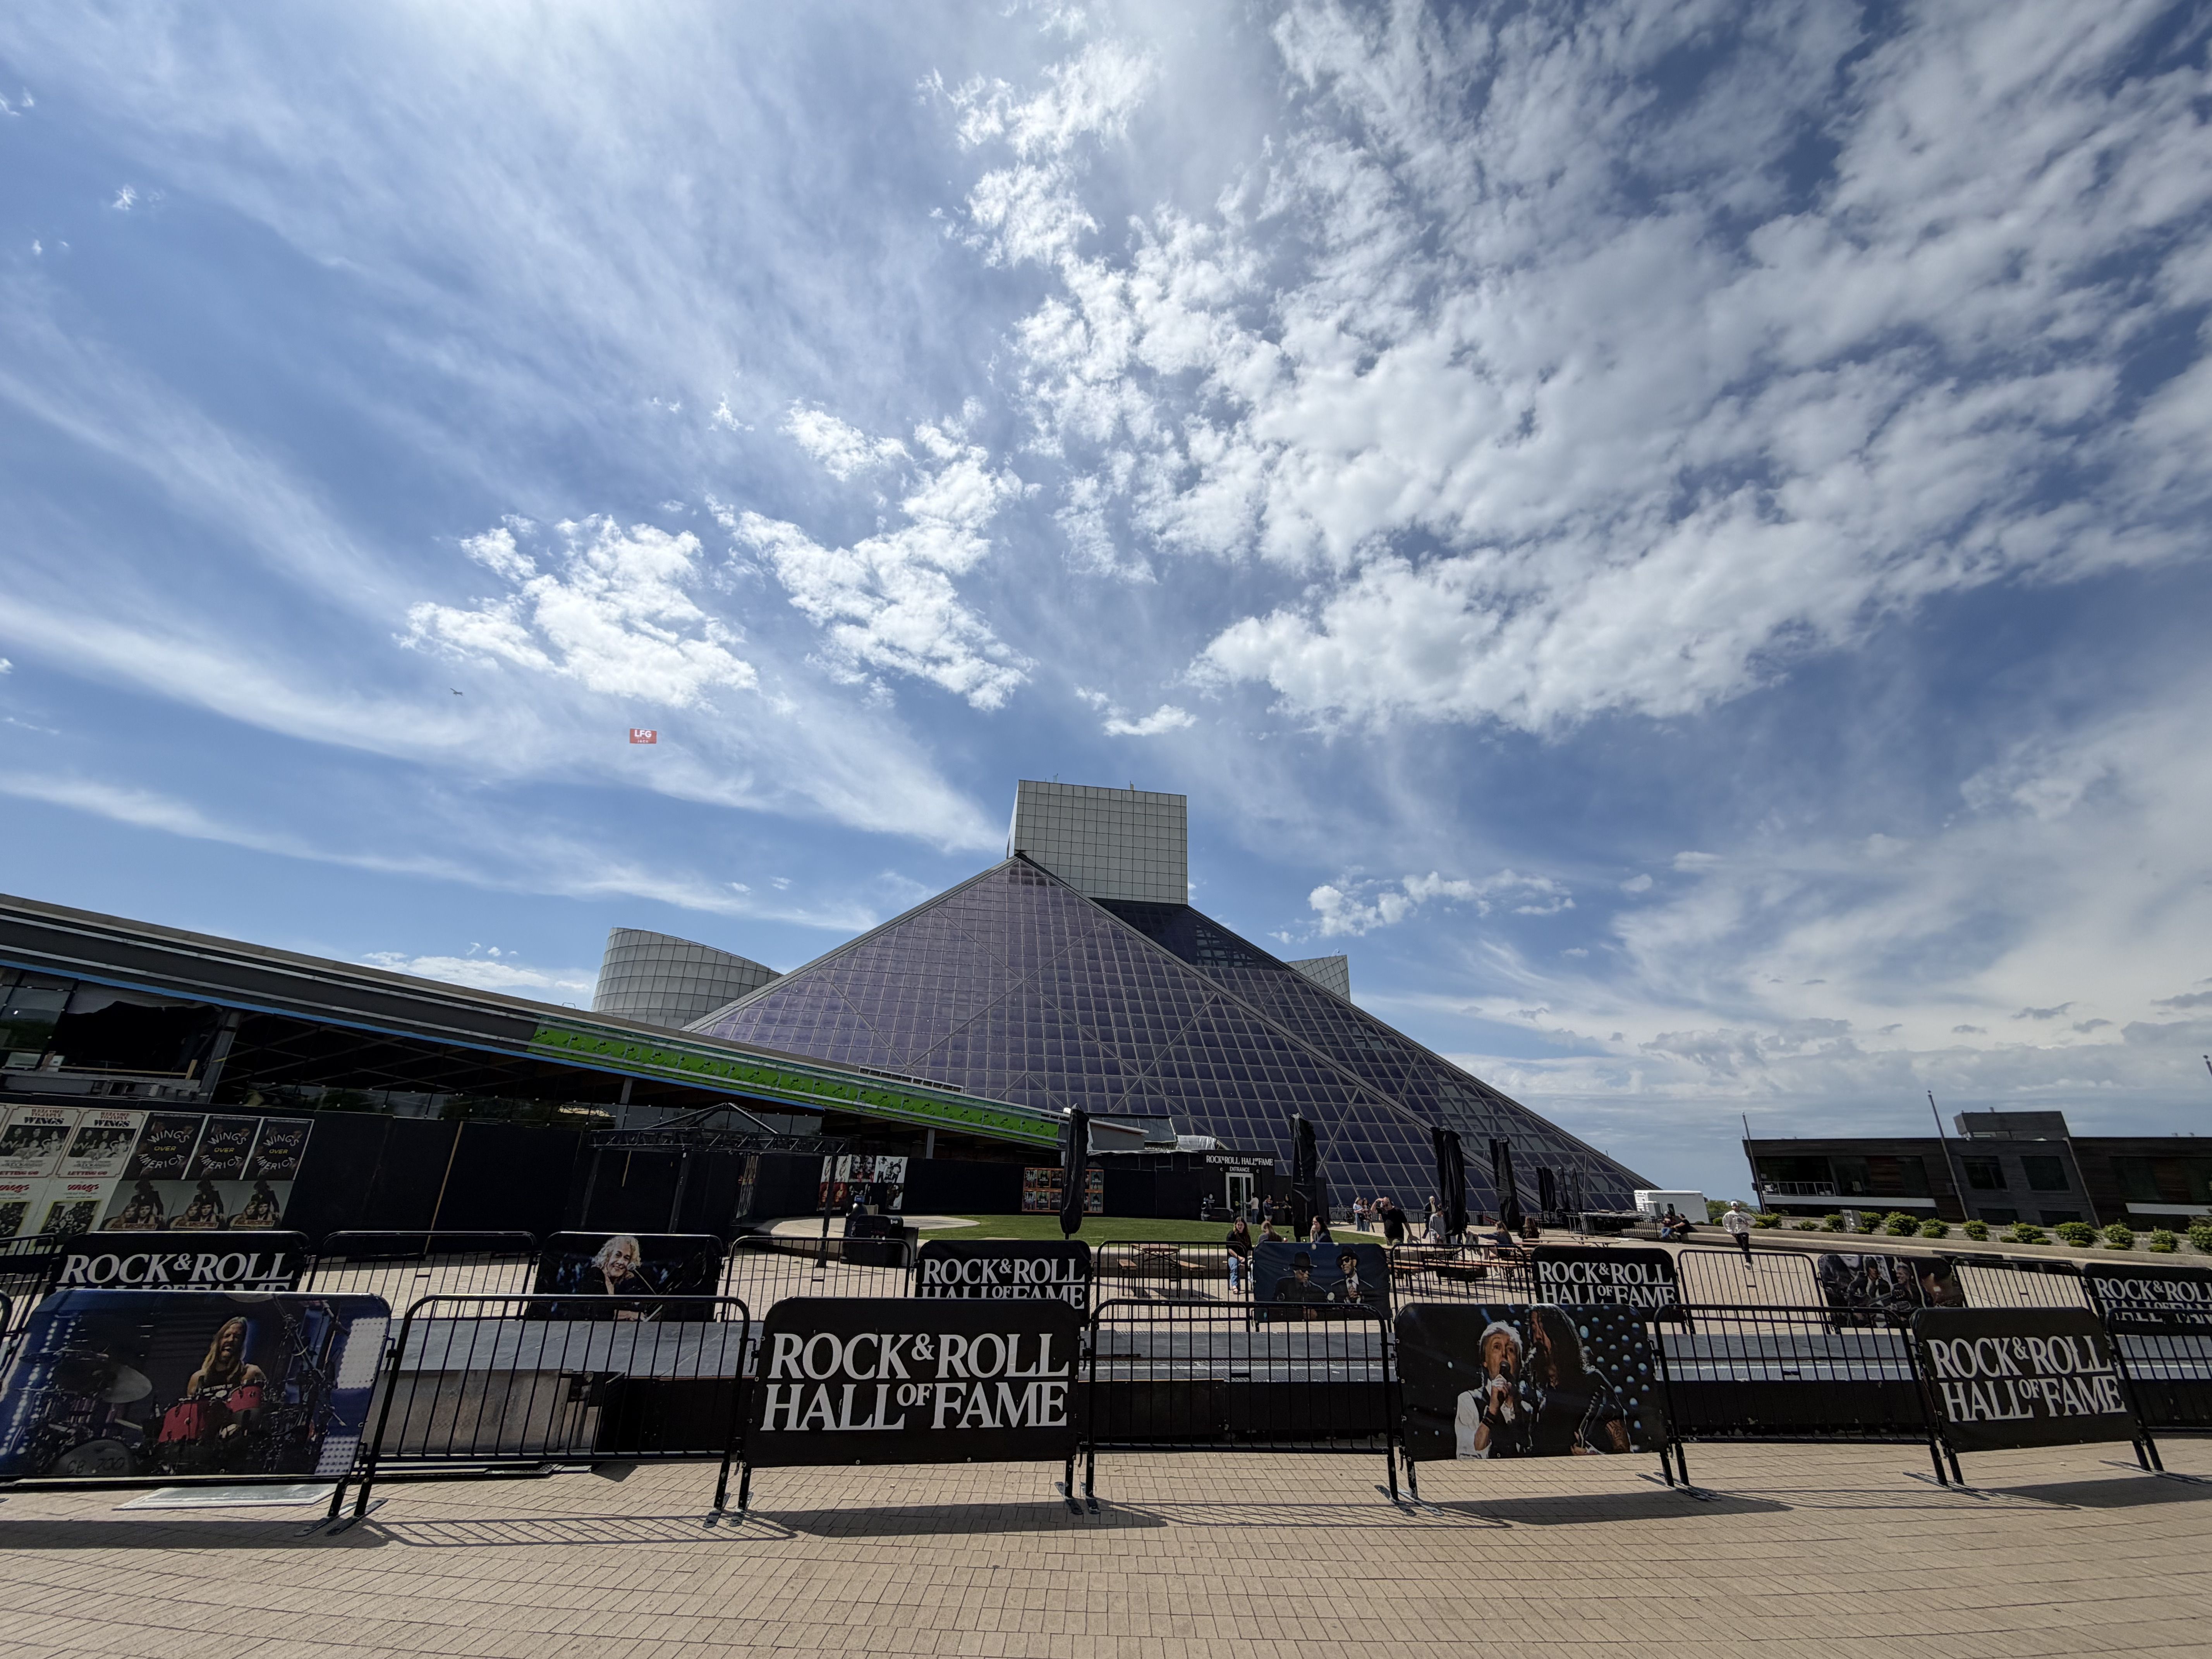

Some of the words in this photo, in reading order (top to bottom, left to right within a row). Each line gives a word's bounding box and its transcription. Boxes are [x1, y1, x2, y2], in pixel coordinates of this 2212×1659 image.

[634, 730, 652, 738] LFG
[147, 1130, 190, 1143] WINGS
[208, 1132, 246, 1145] WINGS
[263, 1134, 299, 1147] WINGS
[138, 1153, 185, 1169] AMERICA
[200, 1154, 243, 1170] AMERICA
[256, 1156, 295, 1170] AMERICA
[1241, 1157, 1257, 1166] HALL
[1259, 1158, 1274, 1166] FAME
[1540, 1283, 1605, 1304] HALL
[1613, 1285, 1678, 1308] FAME
[1938, 1379, 2035, 1423] HALL
[2018, 1378, 2042, 1400] OF
[2038, 1375, 2128, 1418] FAME
[760, 1383, 906, 1432] HALL
[896, 1382, 933, 1407] OF
[931, 1381, 1069, 1429] FAME
